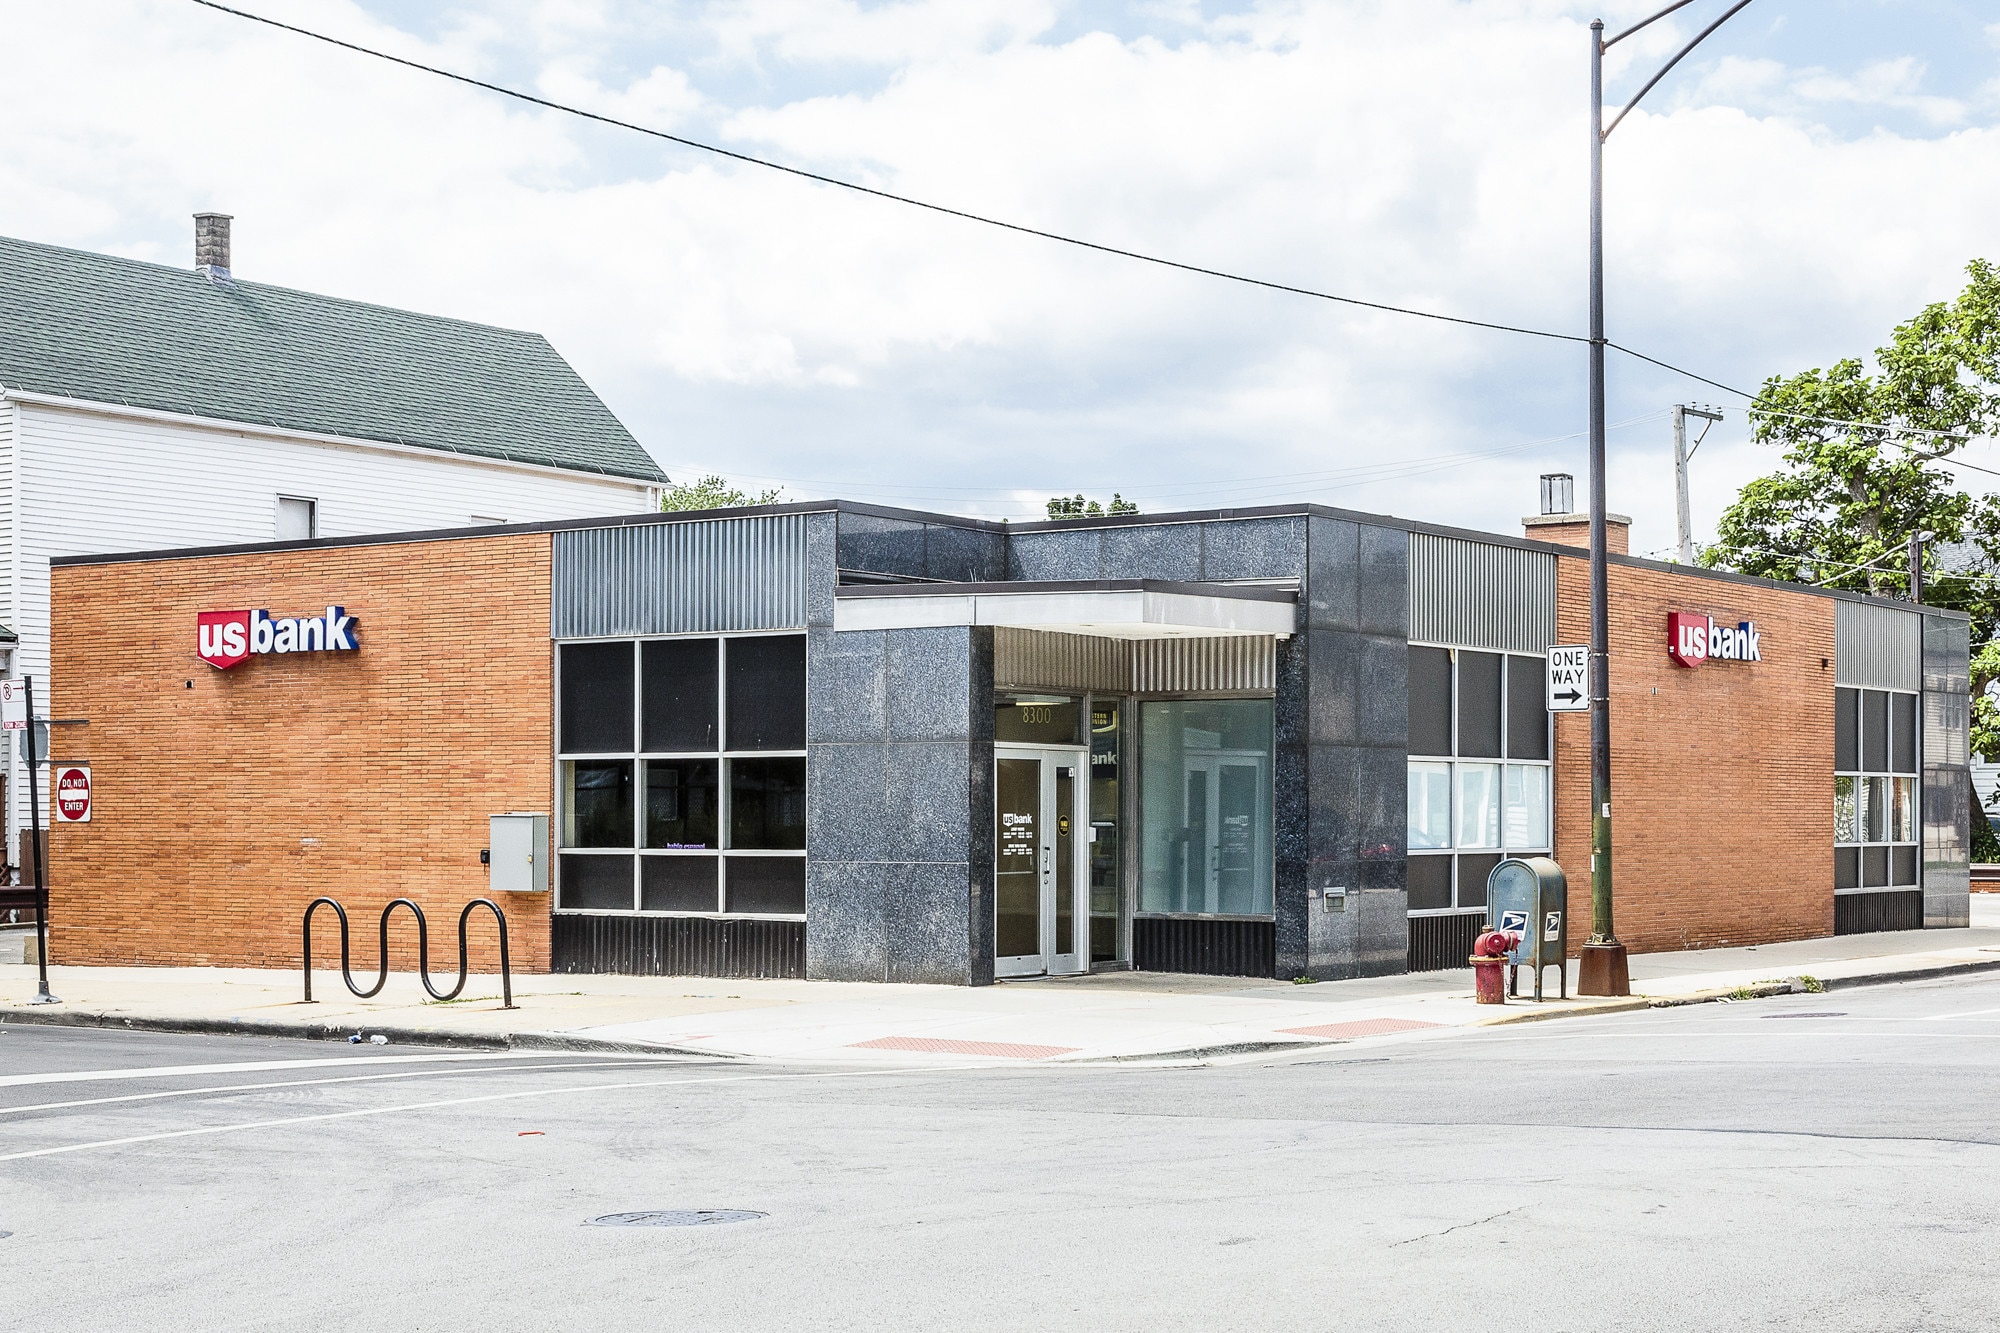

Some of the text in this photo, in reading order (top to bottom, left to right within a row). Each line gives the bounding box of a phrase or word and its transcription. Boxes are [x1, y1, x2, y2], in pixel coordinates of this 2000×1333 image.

[1552, 651, 1584, 666] ONE
[1551, 669, 1584, 685] WAY
[1022, 706, 1051, 724] 8300
[62, 778, 86, 788] DO NOT
[64, 802, 84, 811] ENTER
